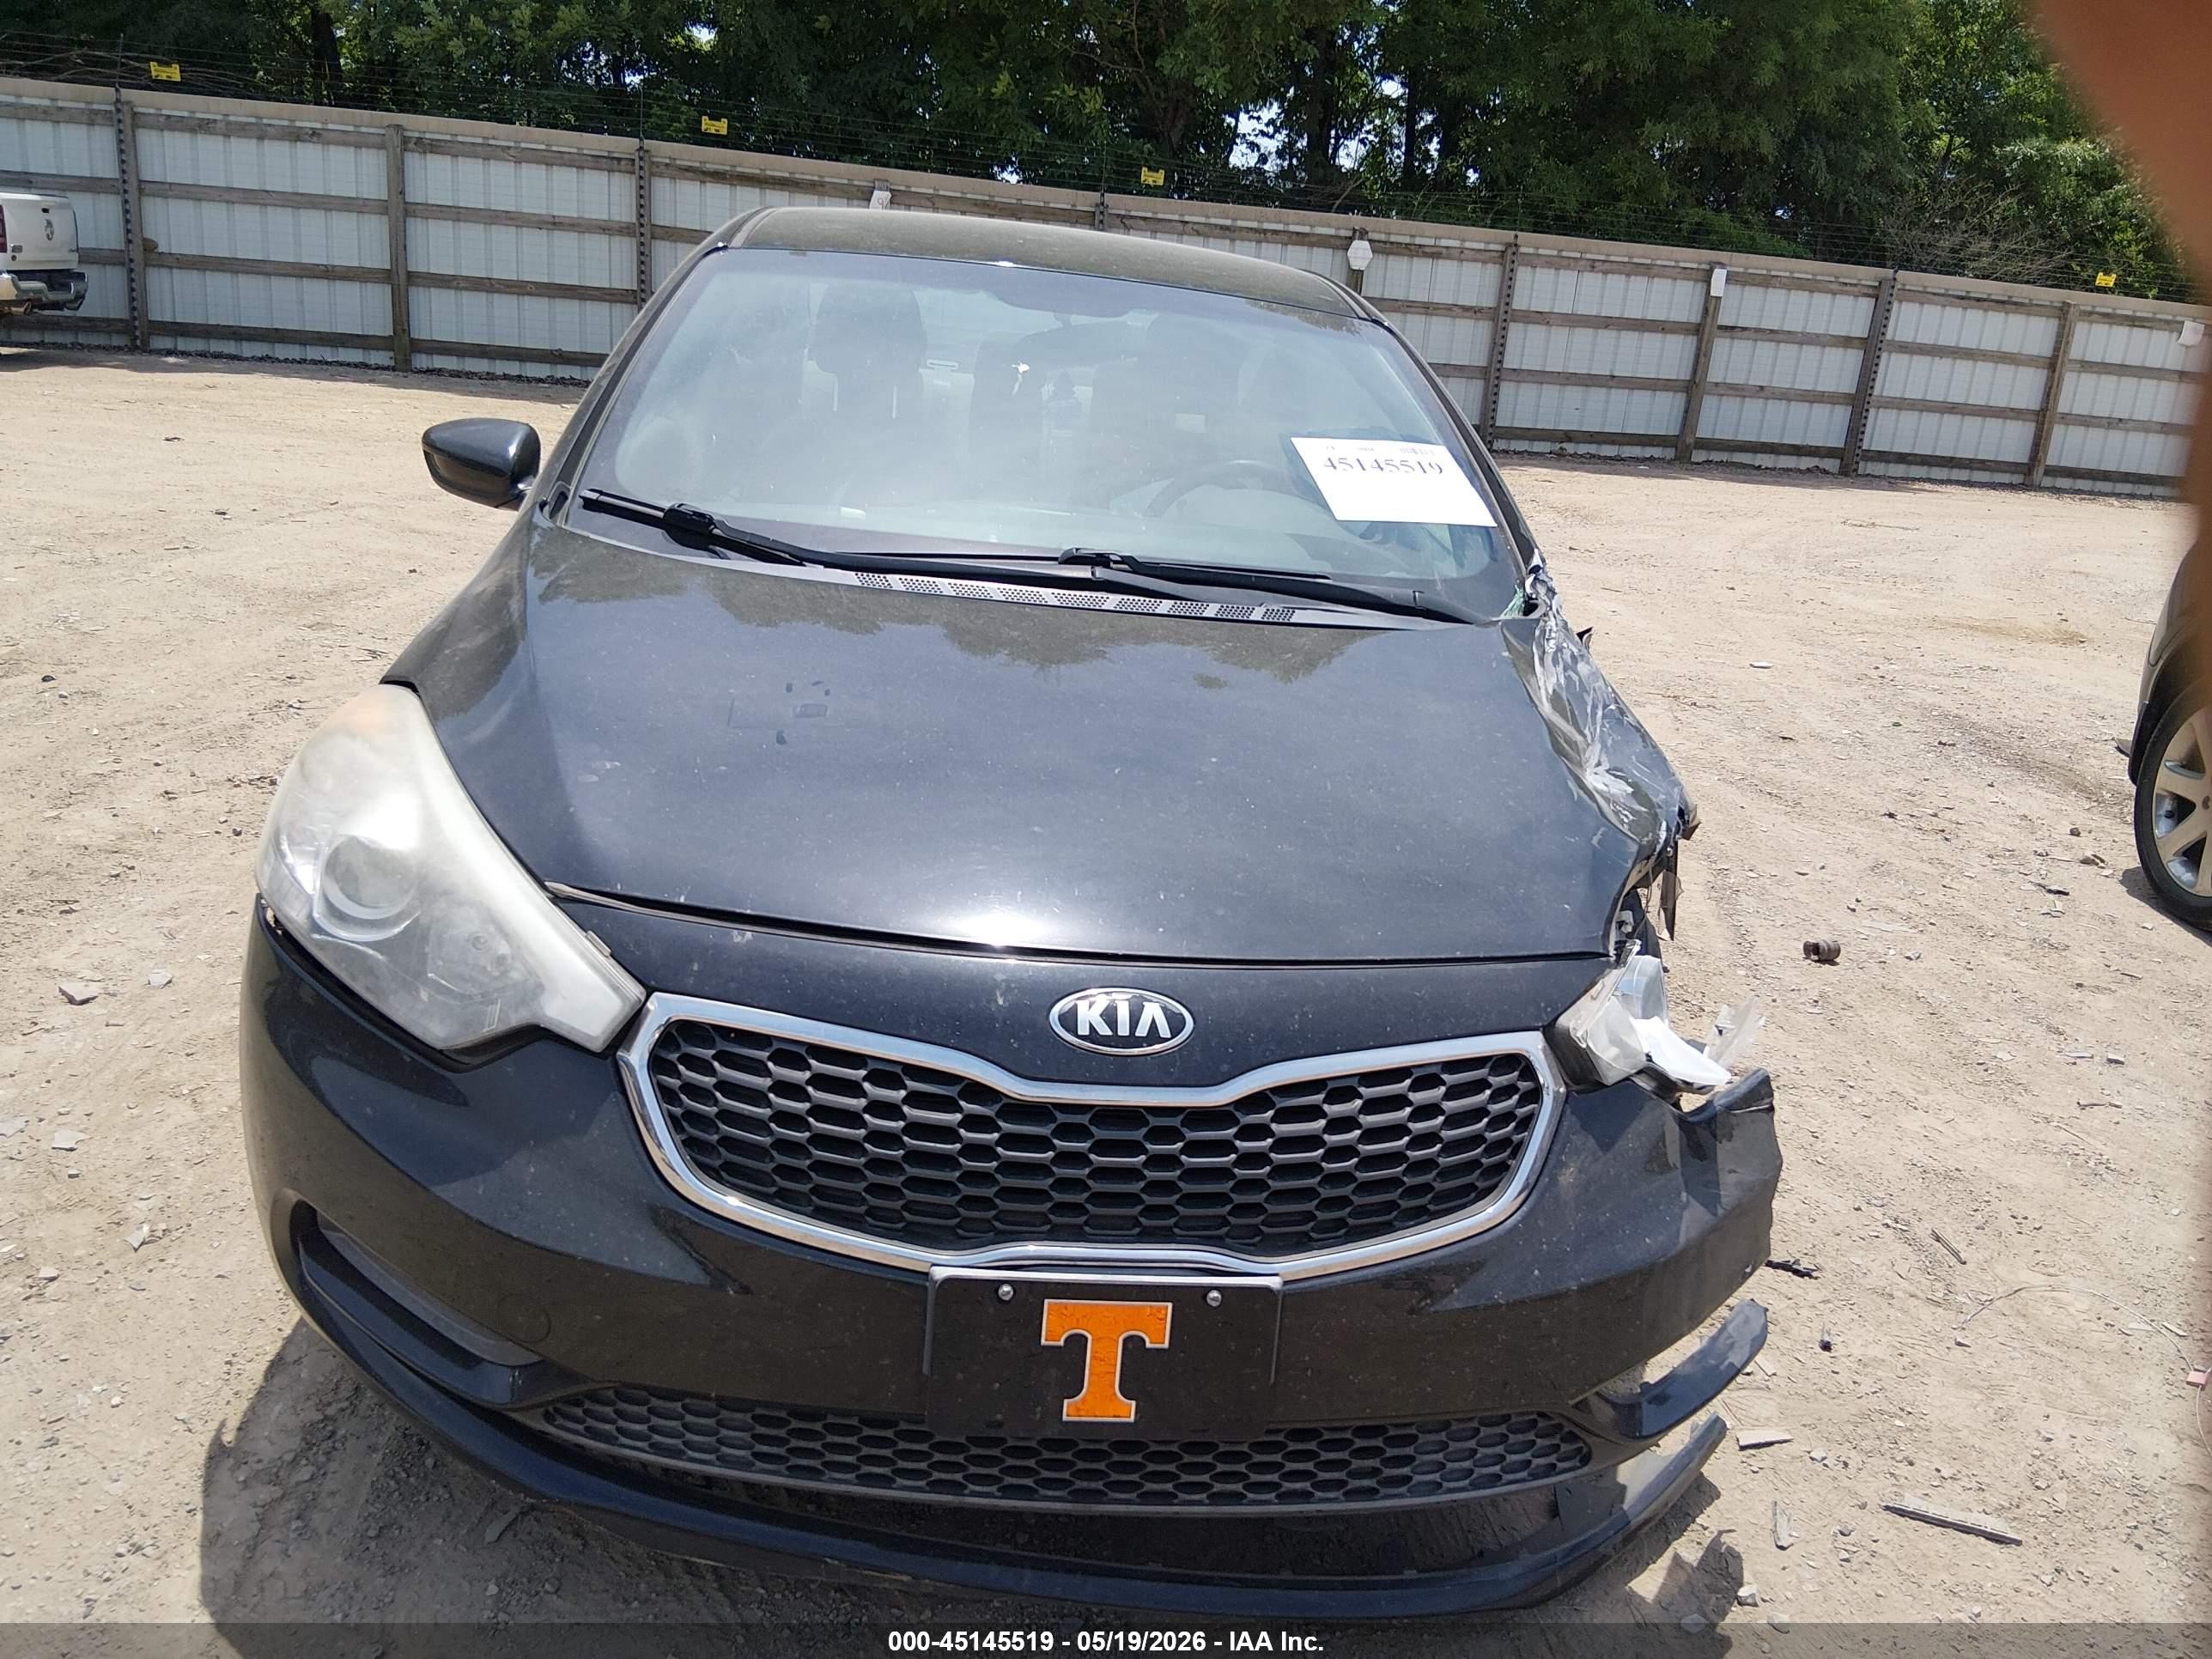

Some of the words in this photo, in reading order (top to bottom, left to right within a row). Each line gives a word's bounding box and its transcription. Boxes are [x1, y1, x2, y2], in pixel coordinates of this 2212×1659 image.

[1323, 456, 1443, 475] 45145519
[1074, 999, 1172, 1039] KIA
[1041, 1298, 1173, 1422] T
